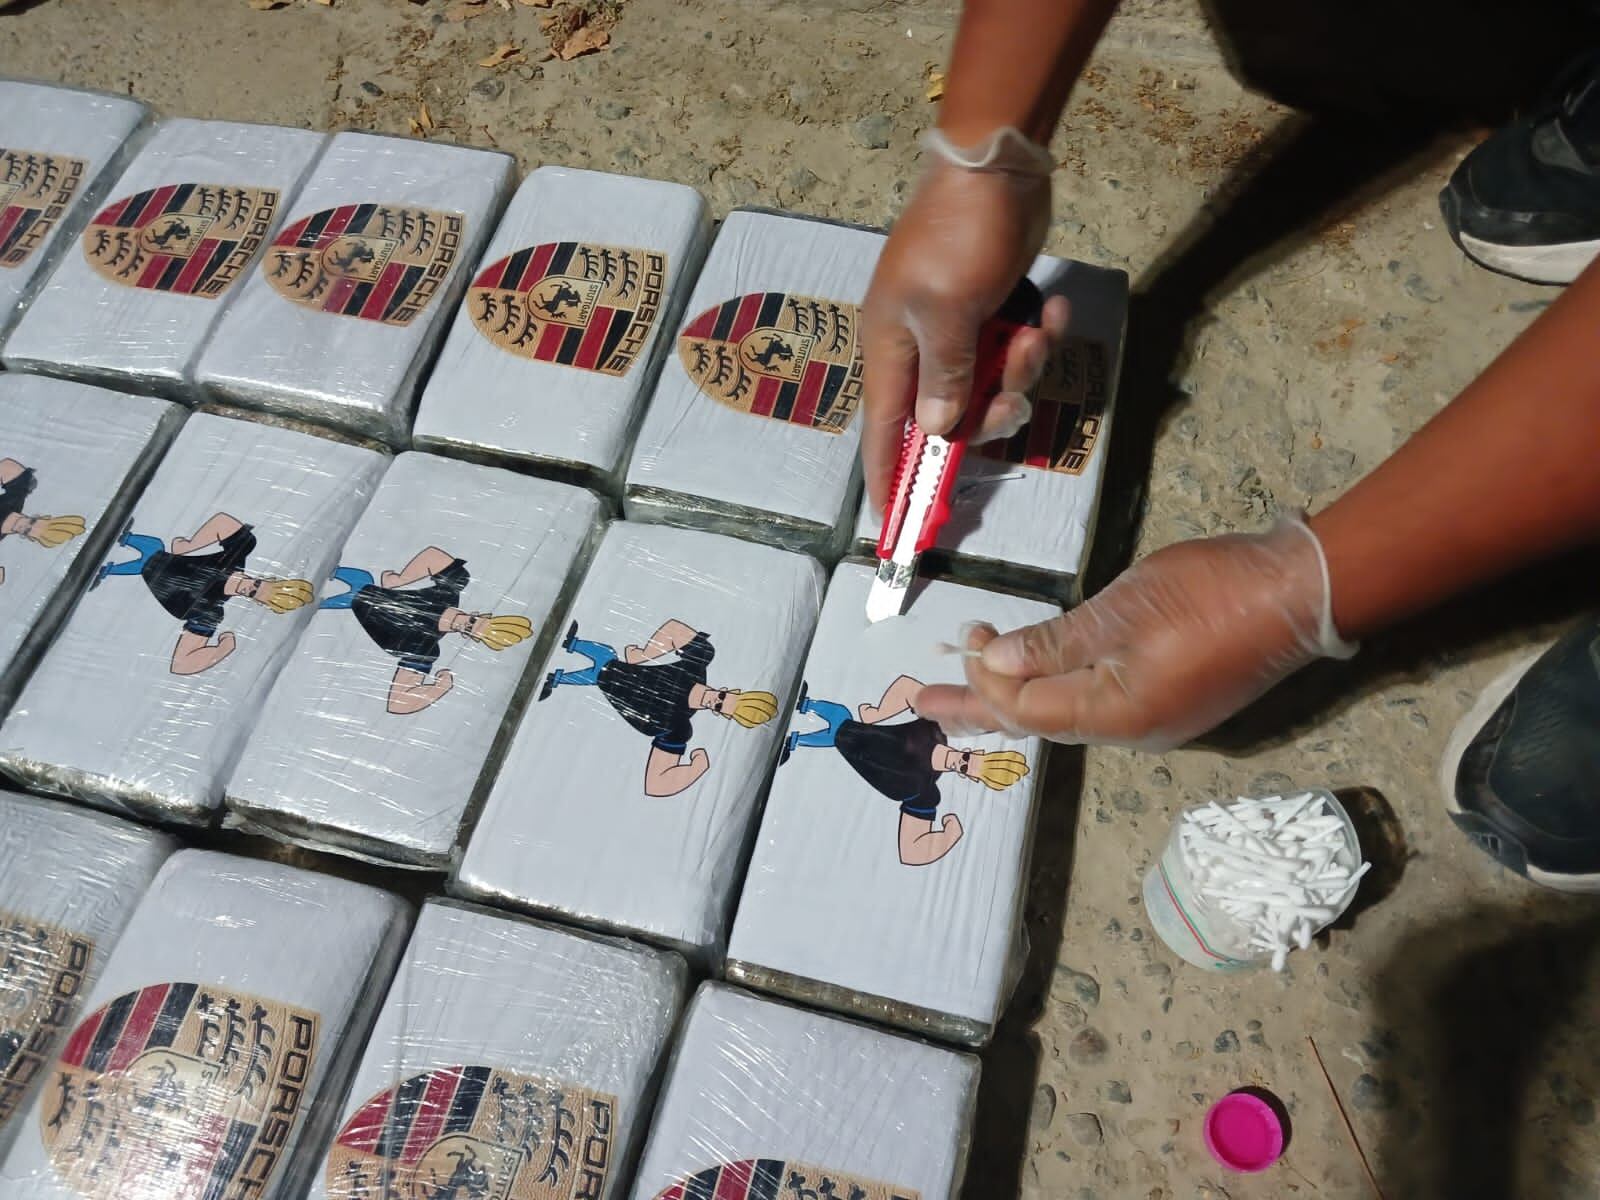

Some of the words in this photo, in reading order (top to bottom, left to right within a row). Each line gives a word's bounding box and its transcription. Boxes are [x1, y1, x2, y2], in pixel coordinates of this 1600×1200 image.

[5, 161, 84, 262] PORSCHE
[201, 192, 276, 296] PORSCHE
[392, 215, 460, 322] PORSCHE
[576, 284, 598, 323] STUTTGART
[605, 254, 663, 371] PORSCHE
[791, 338, 810, 378] STUTTGART
[0, 940, 88, 1118] PORSCH
